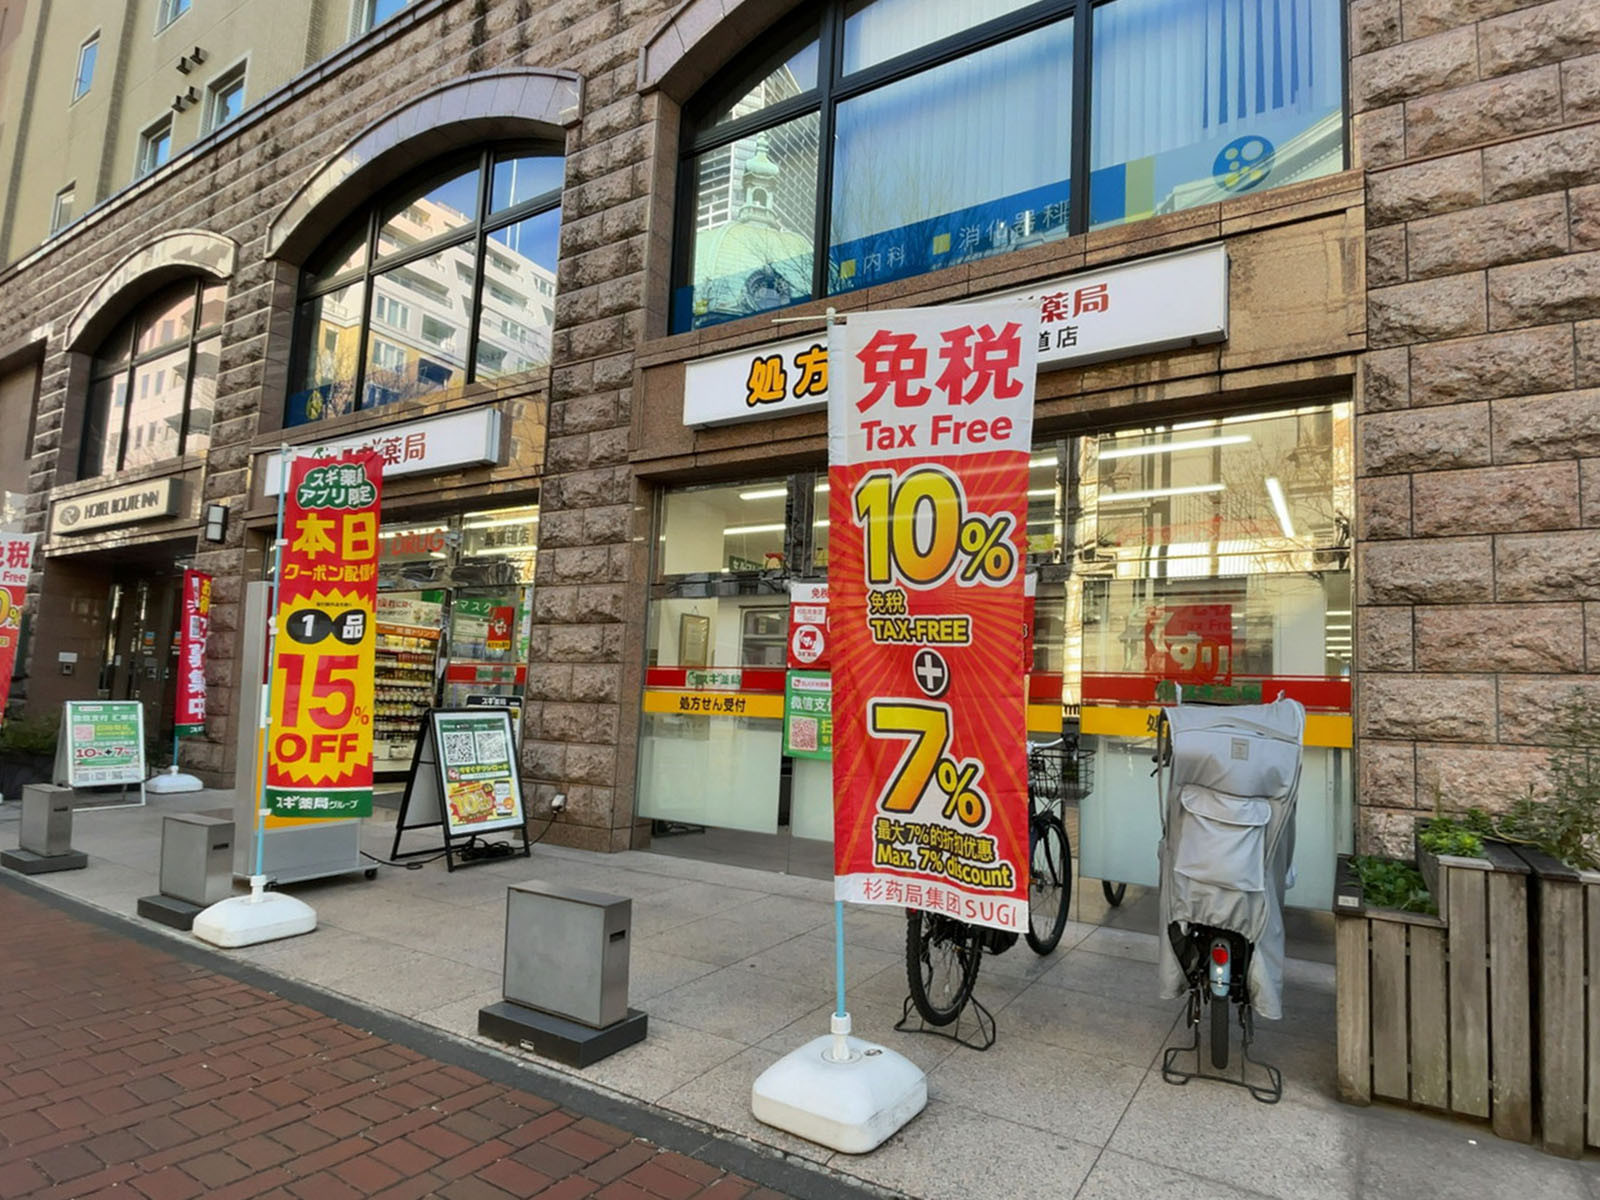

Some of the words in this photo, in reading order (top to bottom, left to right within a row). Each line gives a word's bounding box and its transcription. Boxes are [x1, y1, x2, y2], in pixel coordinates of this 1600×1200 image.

[863, 246, 905, 274] 内科
[856, 321, 1024, 413] 免税
[860, 421, 917, 451] Tax
[930, 415, 1013, 446] Free
[84, 503, 110, 519] HOTEL
[141, 490, 160, 508] INN
[291, 511, 377, 561] 本日
[856, 467, 1015, 583] 10%
[2, 571, 27, 582] Free
[342, 614, 364, 639] 品
[869, 618, 970, 643] TAX-FREE
[278, 653, 369, 731] 15%
[679, 696, 746, 713] 処方せん受付
[275, 732, 360, 764] OFF
[872, 702, 986, 827] 7%
[876, 844, 915, 869] Max.
[918, 849, 945, 874] 7%
[945, 857, 1012, 888] discount
